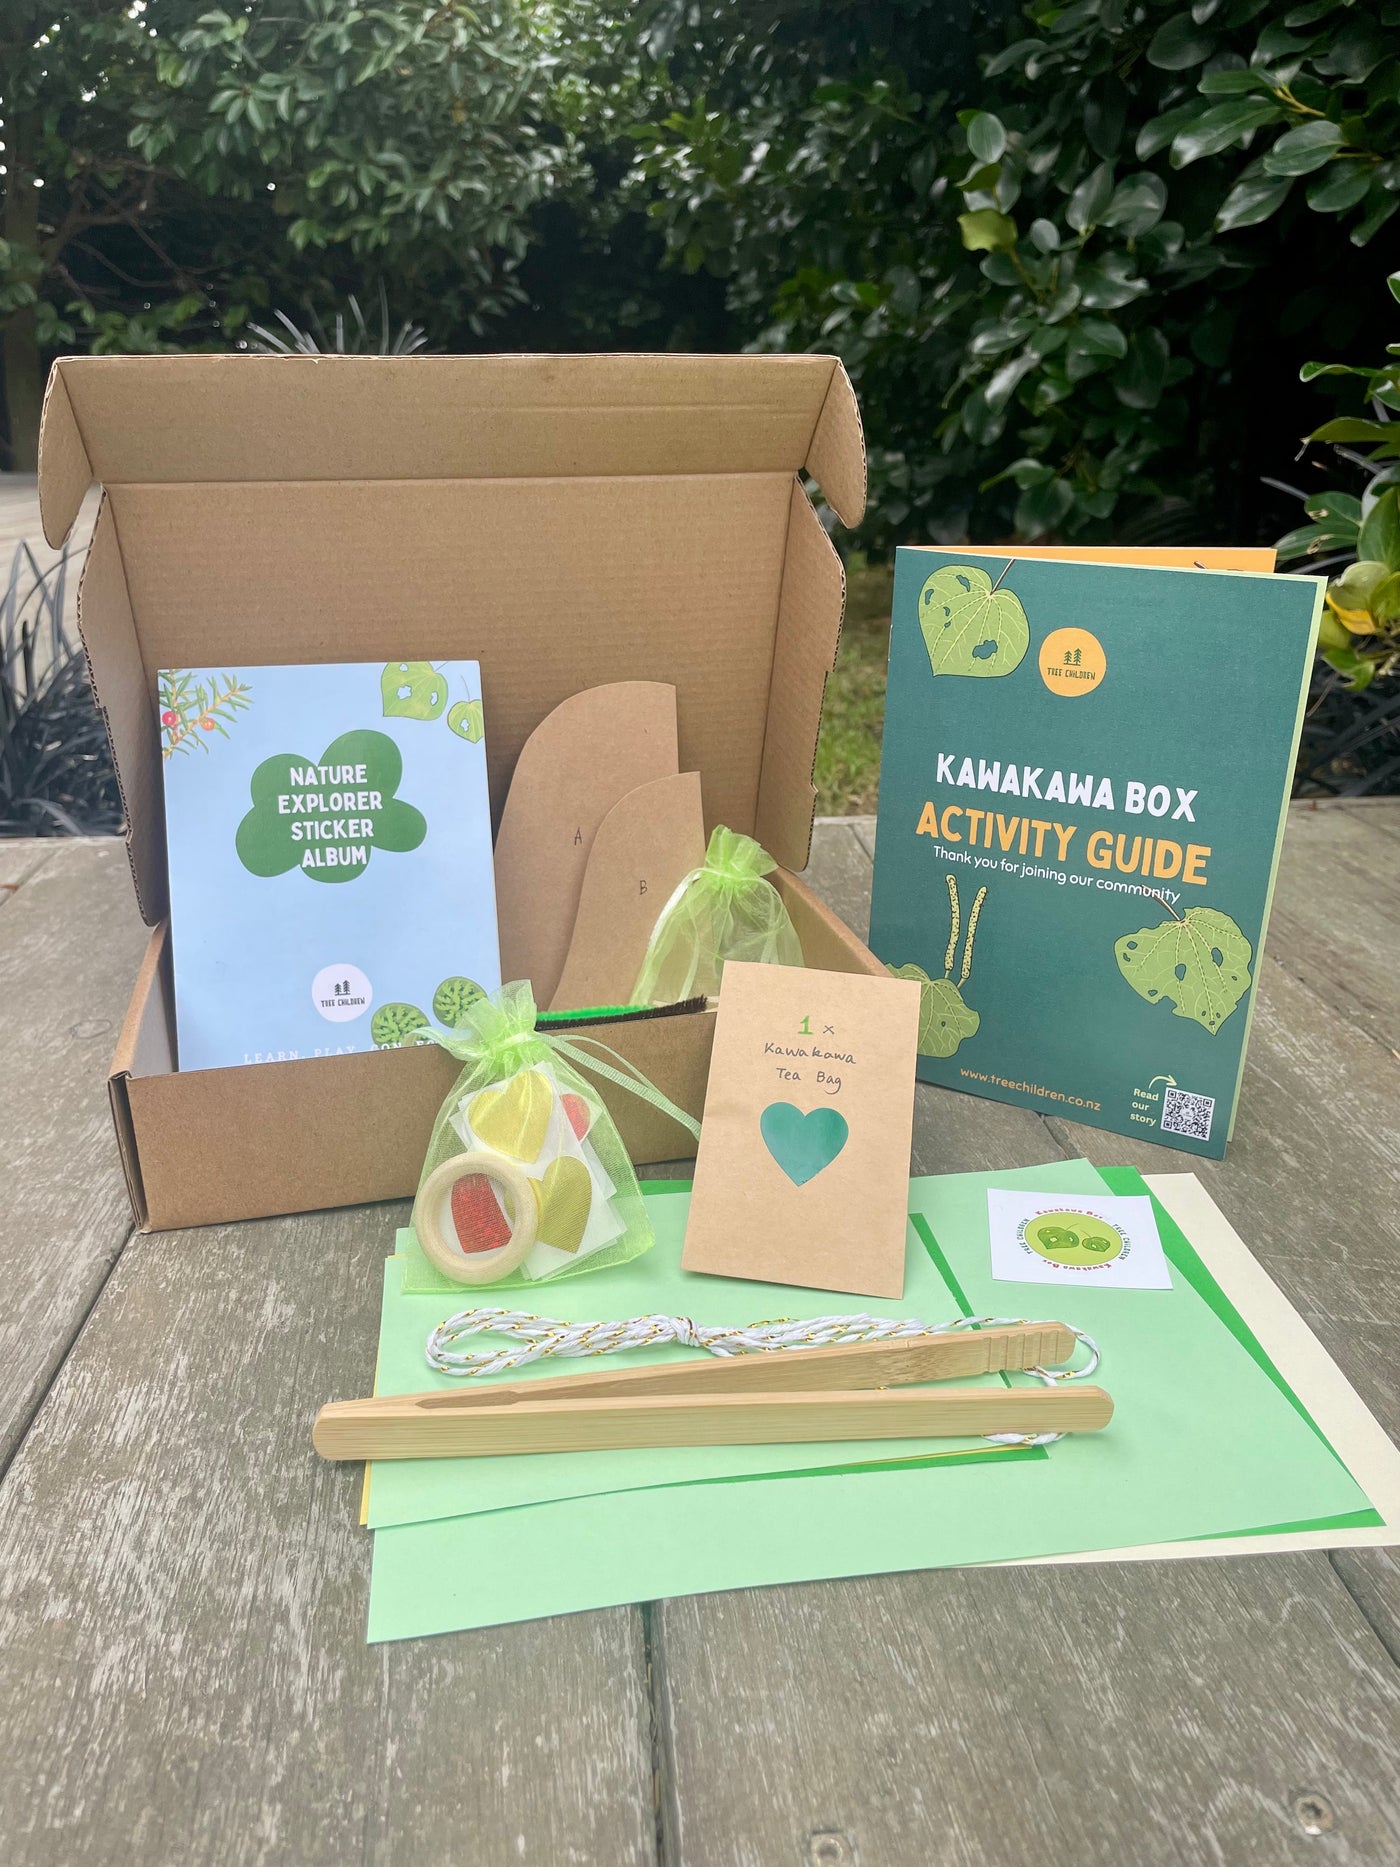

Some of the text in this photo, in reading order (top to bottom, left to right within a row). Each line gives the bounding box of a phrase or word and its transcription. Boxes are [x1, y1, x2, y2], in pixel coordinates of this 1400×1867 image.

[1047, 667, 1096, 681] TREE CHILDREN
[289, 763, 368, 787] NATURE
[935, 752, 1199, 823] KAWAKAWA BOX
[277, 790, 383, 815] EXPLORER
[290, 818, 374, 842] STICKER
[574, 826, 583, 846] A
[915, 801, 1213, 886] ACTIVITY GUIDE
[301, 845, 368, 869] ALBUM
[933, 845, 1182, 905] Thank you for joining our community
[640, 879, 648, 896] B
[797, 1014, 814, 1036] 1
[764, 1041, 857, 1065] Kawakawa
[775, 1067, 842, 1096] Tea Bag
[959, 1067, 1102, 1112] www.treechildren.co.nz
[1131, 1101, 1150, 1112] our
[1133, 1087, 1160, 1102] Read
[1129, 1112, 1157, 1128] story
